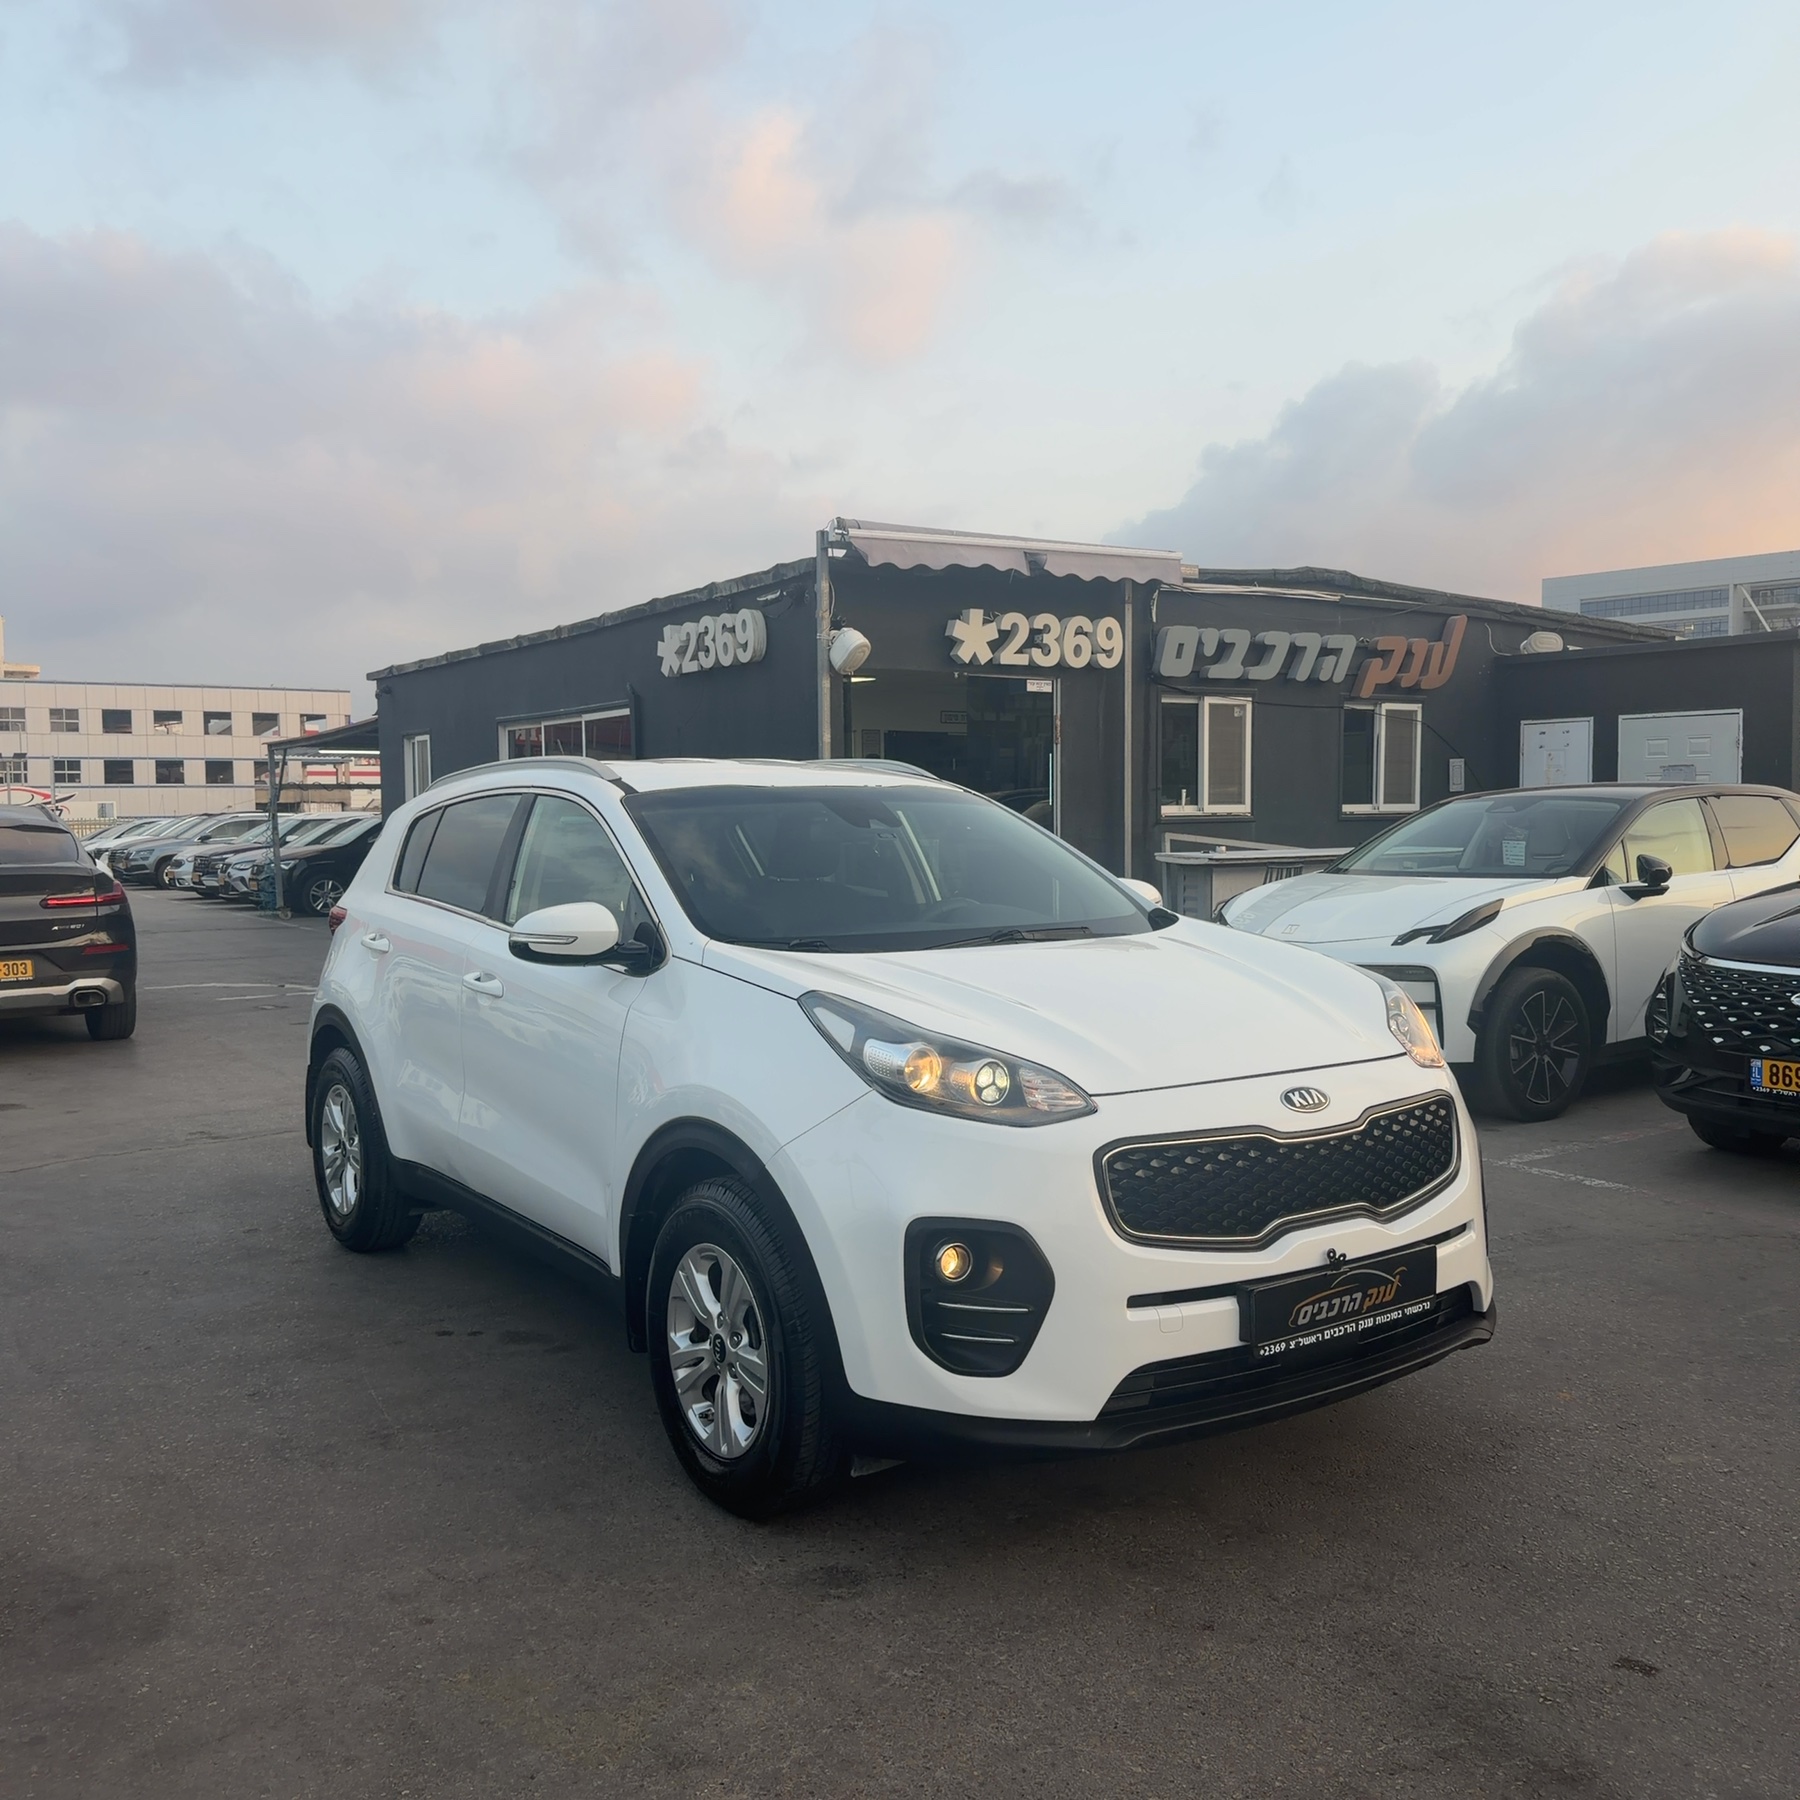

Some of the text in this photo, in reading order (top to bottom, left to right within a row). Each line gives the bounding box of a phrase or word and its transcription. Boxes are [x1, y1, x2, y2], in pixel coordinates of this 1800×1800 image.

[1154, 614, 1468, 698] ענק הרכבים
[1287, 1089, 1326, 1107] KIA
[1297, 1273, 1402, 1326] ענק הרכבים
[1358, 1318, 1374, 1332] ענק
[1375, 1310, 1403, 1325] בסוכנות
[1324, 1321, 1356, 1339] הרכבים
